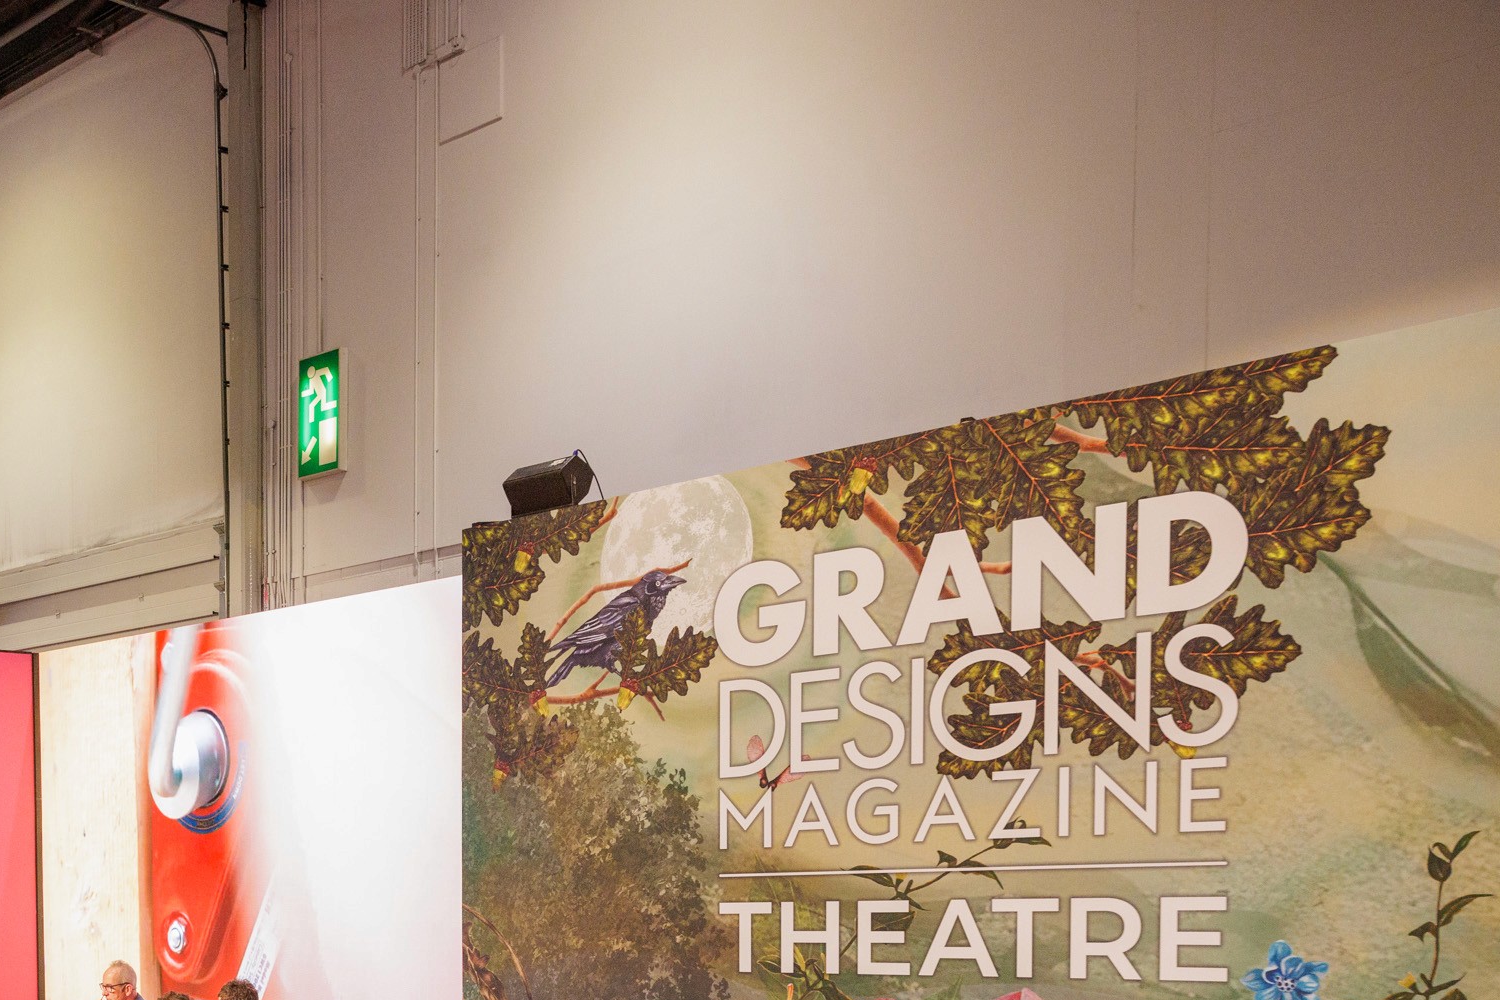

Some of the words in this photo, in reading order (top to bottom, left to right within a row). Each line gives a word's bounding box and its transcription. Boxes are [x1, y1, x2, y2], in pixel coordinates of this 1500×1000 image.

[713, 490, 1250, 668] GRAND
[716, 623, 1240, 781] DESIGNS
[718, 756, 1228, 851] MAGAZINE
[718, 896, 1230, 984] THEATRE
